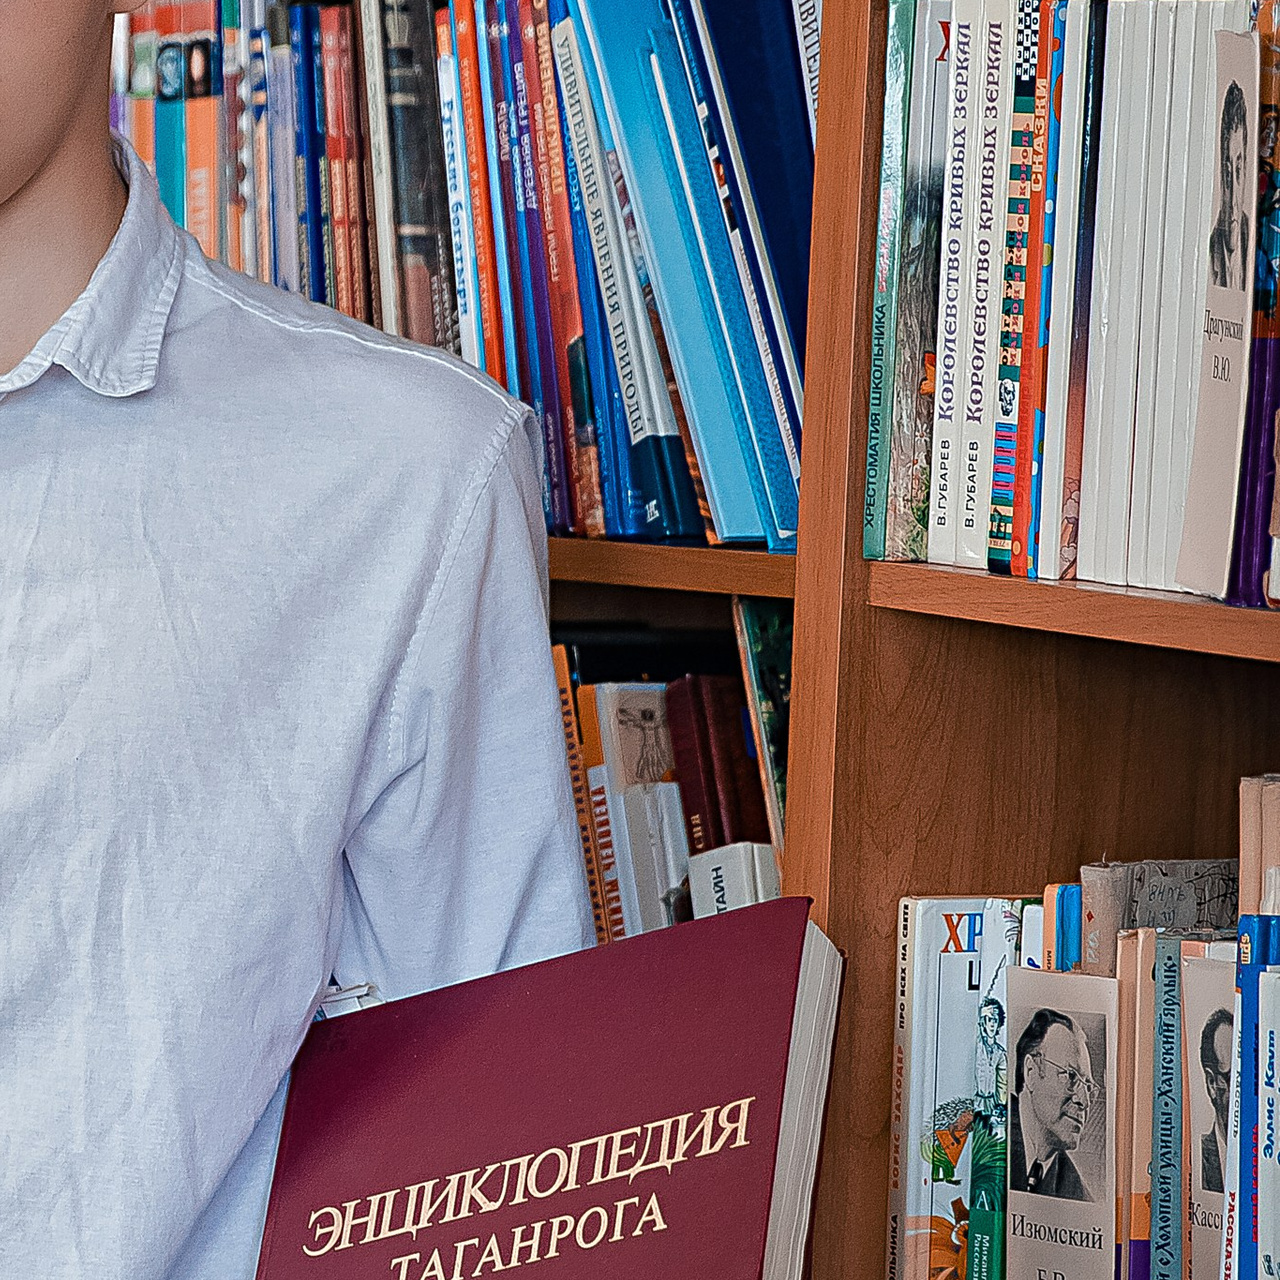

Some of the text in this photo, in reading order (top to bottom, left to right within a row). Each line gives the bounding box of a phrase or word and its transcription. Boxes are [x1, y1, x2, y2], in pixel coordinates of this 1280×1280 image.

[496, 100, 511, 162] ПИРАТЫ
[514, 61, 539, 210] ДРЕВНЯЯ ГРЕЦИЯ
[536, 21, 564, 195] ПРИКЛЮЧЕНИЯ
[1018, 122, 1031, 197] КОРОЛЬ
[1031, 77, 1048, 192] СКАЗКИ
[556, 35, 645, 437] УДИВИТЕЛЬНЫЕ ЯВЛЕНИЯ ПРИРОДЫ
[870, 303, 887, 407] ШКОЛЬНИКА
[937, 438, 950, 527] В.ГУБАРЕВ
[948, 125, 967, 231] КРИВЫХ
[964, 440, 979, 529] В.ГУБАРЕВ
[978, 125, 997, 232] КРИВЫХ
[1203, 309, 1245, 343] Драгунский
[1212, 354, 1231, 383] В.Ю.
[864, 413, 881, 529] ХРЕСТОМАТИЯ
[897, 903, 910, 1030] ПРО ВСЕХ НА СВЕТЕ
[890, 1044, 905, 1190] БОРИС ЗАХОДЕР
[1262, 1029, 1275, 1160] Эллис Каут
[301, 1096, 756, 1257] ЭНЦИКЛОПЕДИЯ
[1011, 1213, 1104, 1250] Изюмский
